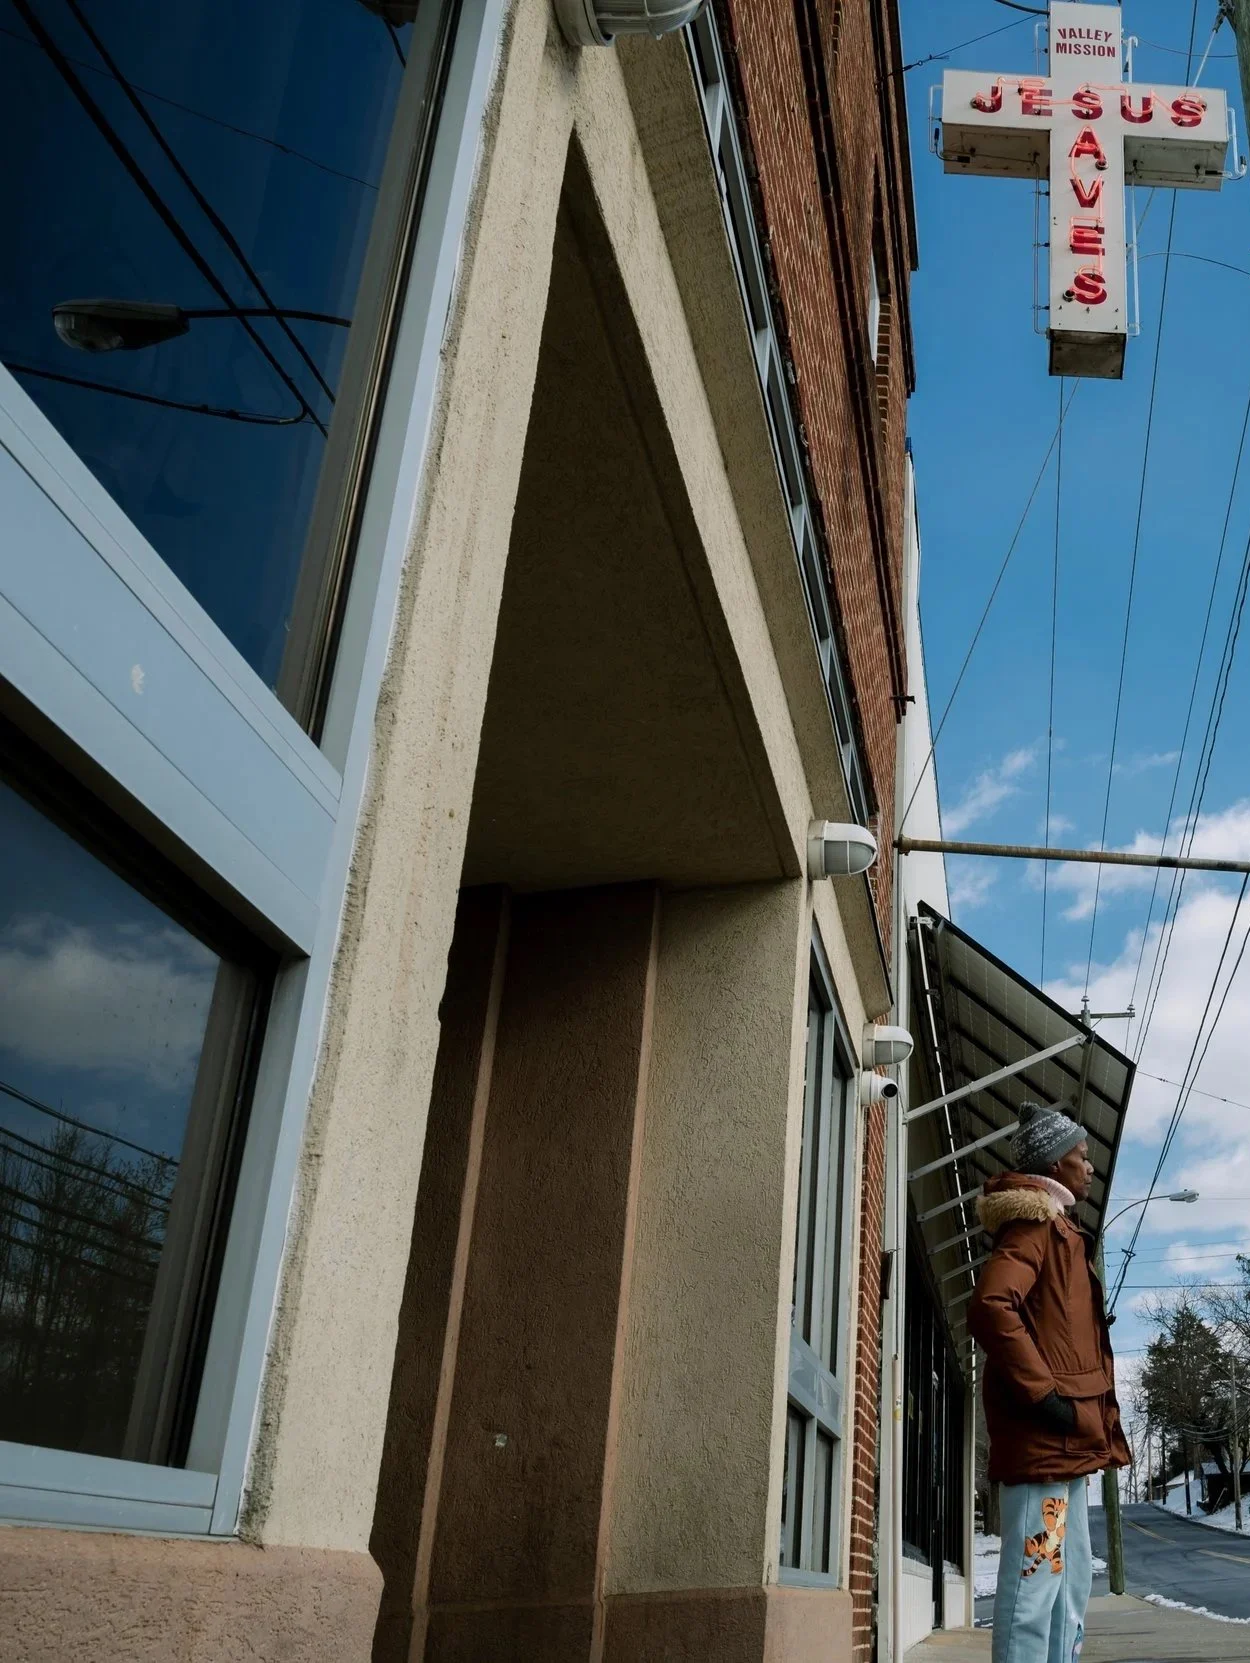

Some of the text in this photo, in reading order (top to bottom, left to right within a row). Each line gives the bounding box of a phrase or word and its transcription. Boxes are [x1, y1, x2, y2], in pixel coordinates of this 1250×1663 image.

[1057, 27, 1113, 42] VALLEY
[1055, 42, 1116, 58] MISSION
[972, 79, 1208, 128] JESUS
